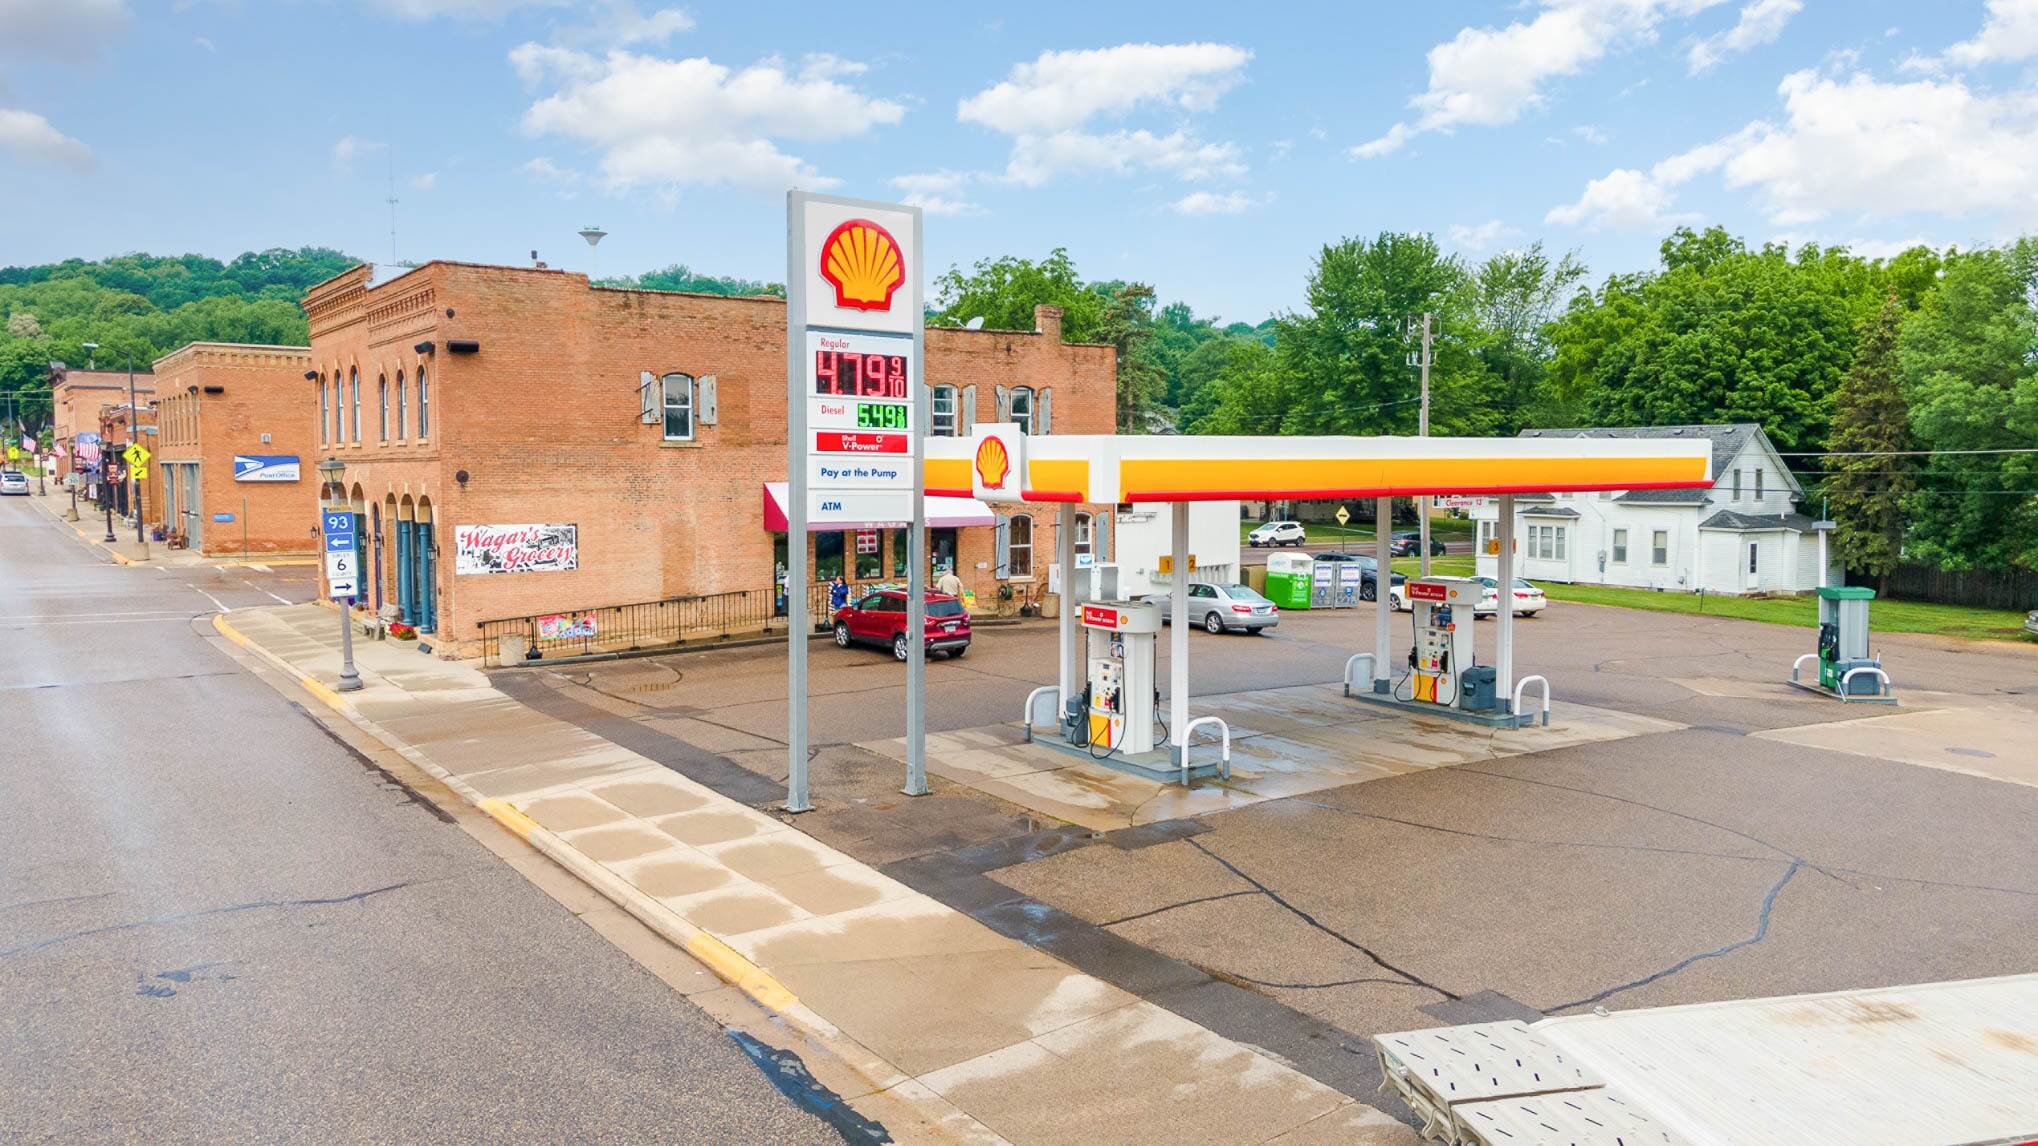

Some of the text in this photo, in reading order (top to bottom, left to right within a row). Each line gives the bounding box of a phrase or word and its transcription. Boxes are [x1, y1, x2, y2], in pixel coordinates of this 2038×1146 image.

[820, 337, 850, 350] Regular
[821, 404, 845, 415] Diesel
[841, 434, 857, 442] Shell
[842, 441, 880, 451] V-Power
[821, 467, 897, 480] Pay at the Pump
[821, 501, 842, 511] ATM
[1445, 499, 1473, 507] Clearance
[328, 516, 348, 530] 93
[460, 526, 540, 553] Wagar's
[1494, 542, 1499, 551] 3
[503, 546, 574, 569] Grocery
[337, 558, 347, 571] 6
[1165, 560, 1170, 570] 1
[1188, 559, 1195, 569] 2
